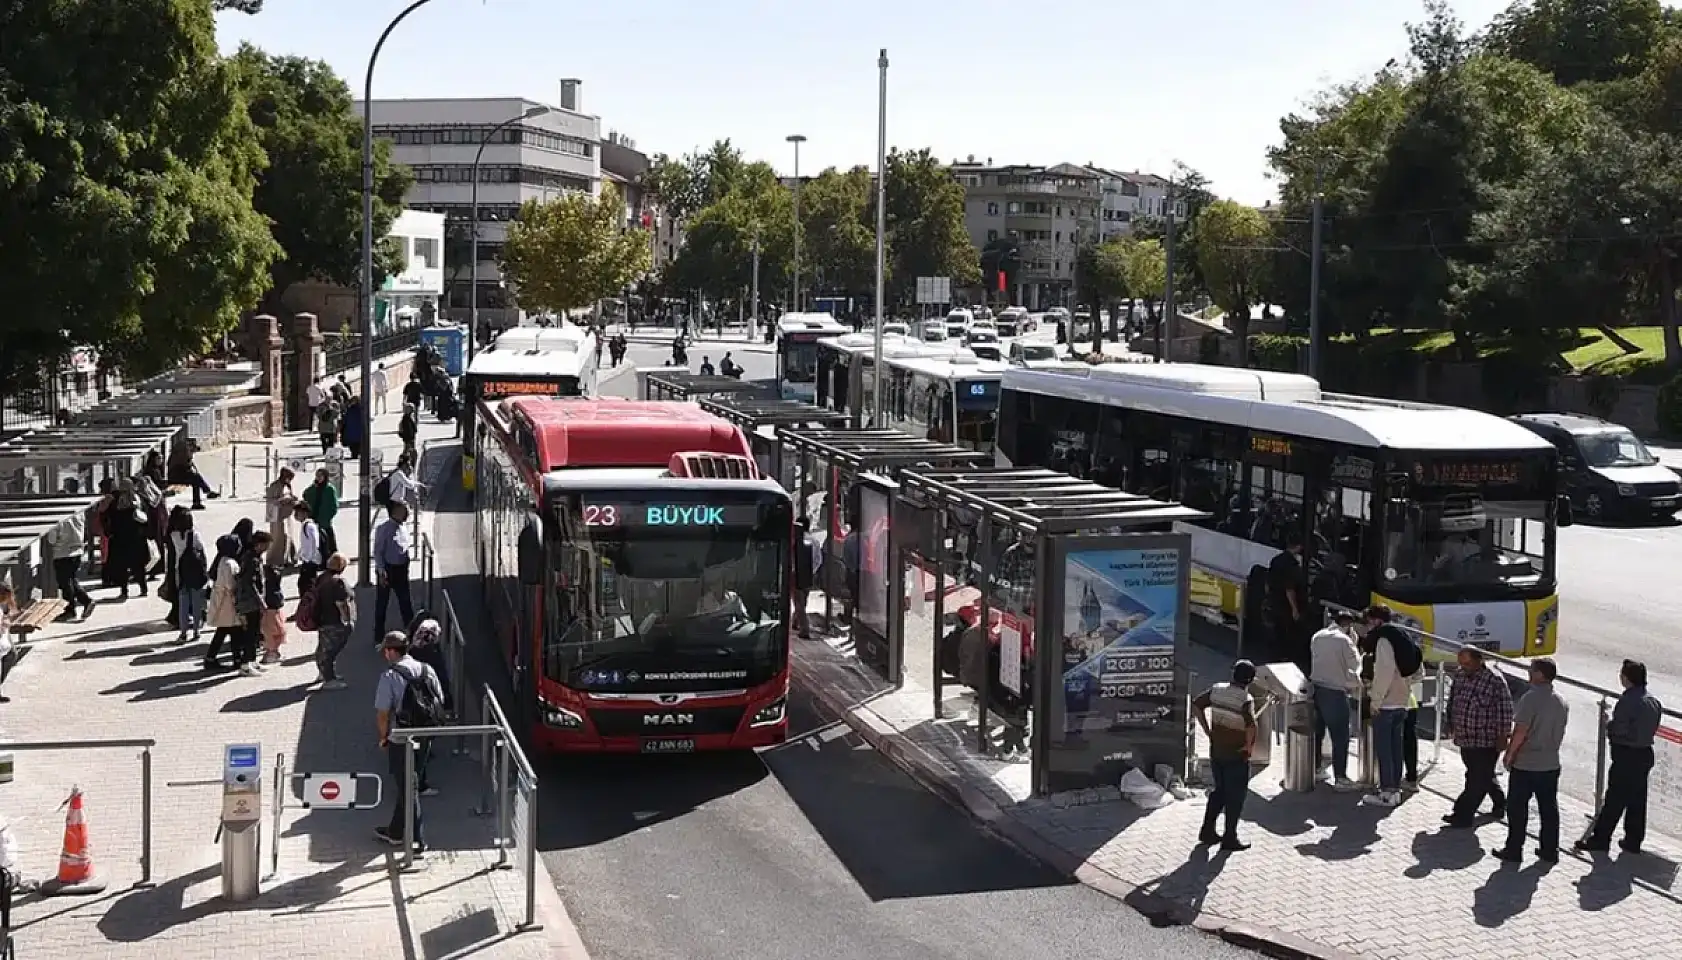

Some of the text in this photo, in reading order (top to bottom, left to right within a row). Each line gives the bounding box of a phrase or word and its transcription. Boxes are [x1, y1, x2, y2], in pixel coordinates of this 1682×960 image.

[970, 384, 985, 396] 65
[585, 504, 725, 526] 23 BÜYÜK
[1147, 657, 1169, 669] 100
[644, 672, 668, 681] KONYA
[1146, 682, 1168, 696] 120
[643, 714, 694, 725] MAN
